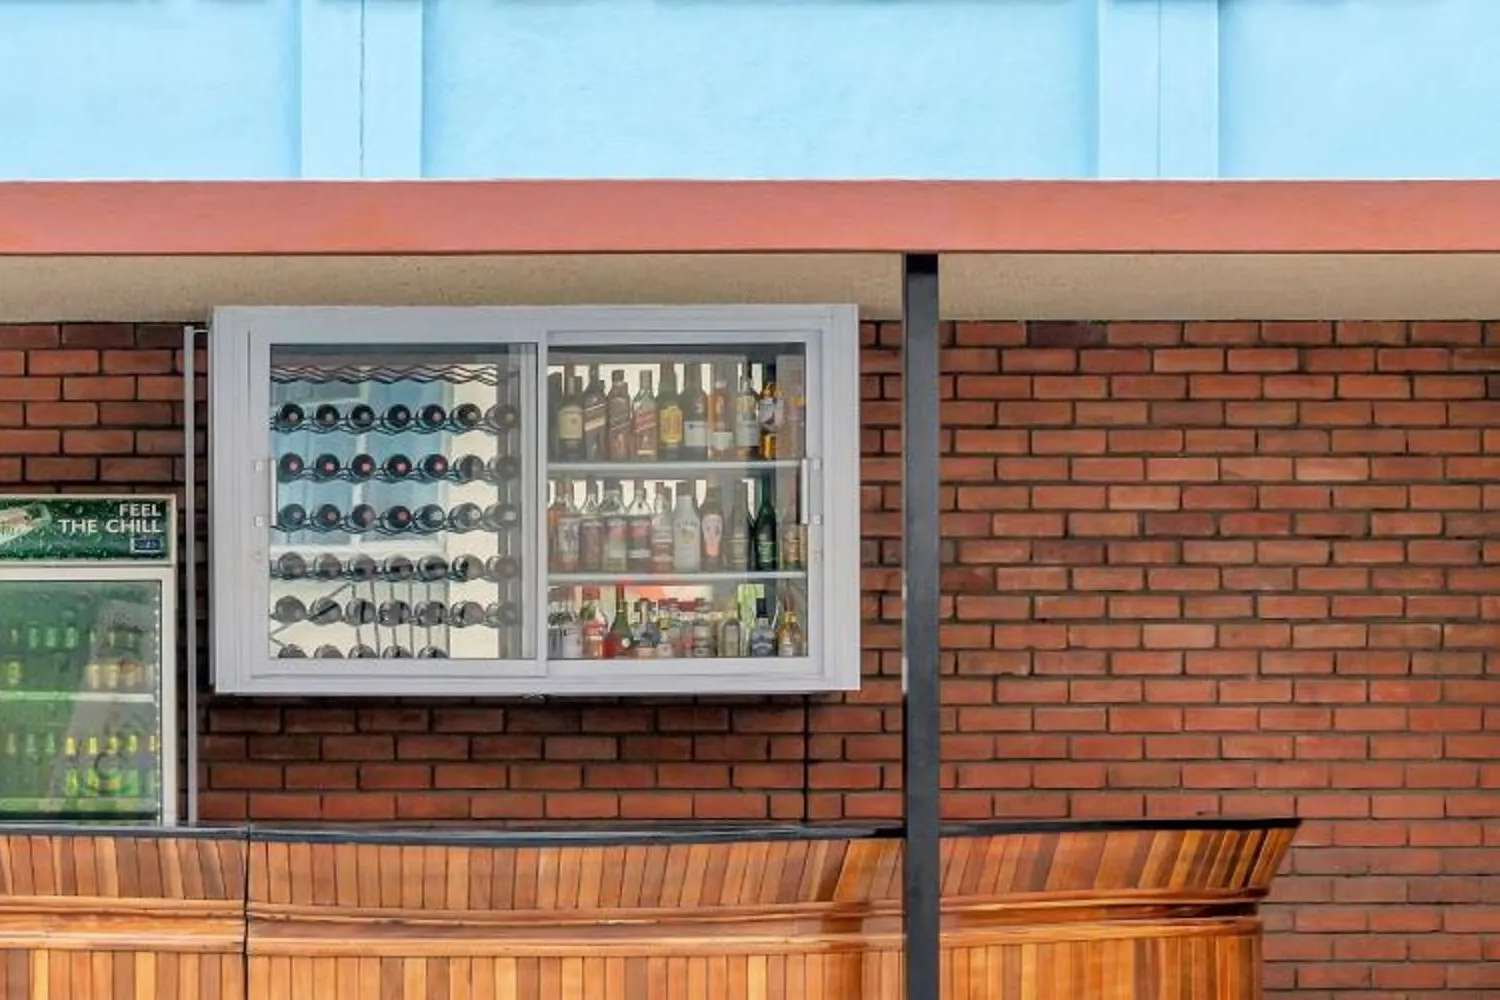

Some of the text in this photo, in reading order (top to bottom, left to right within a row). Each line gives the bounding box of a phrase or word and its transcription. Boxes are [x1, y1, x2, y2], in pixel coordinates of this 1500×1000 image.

[119, 503, 161, 517] FEEL
[57, 519, 163, 533] THE CHILL
